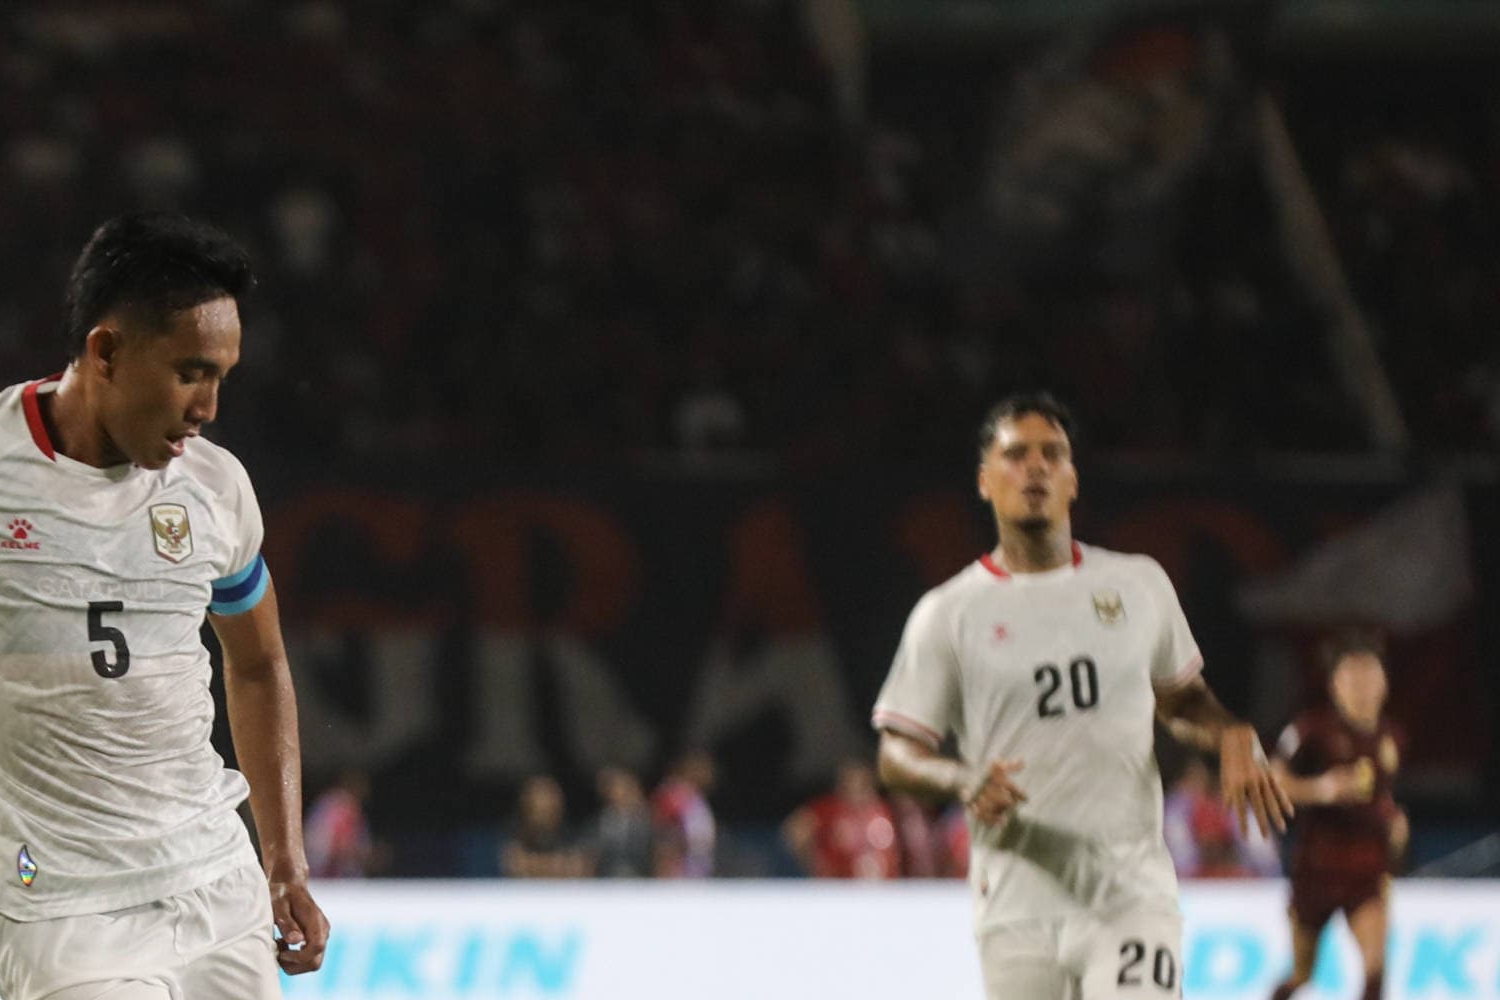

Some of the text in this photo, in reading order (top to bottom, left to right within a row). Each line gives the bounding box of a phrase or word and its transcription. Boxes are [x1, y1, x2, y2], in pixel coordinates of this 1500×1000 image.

[88, 601, 130, 678] 5
[1034, 655, 1100, 719] 20
[1117, 938, 1178, 992] 20
